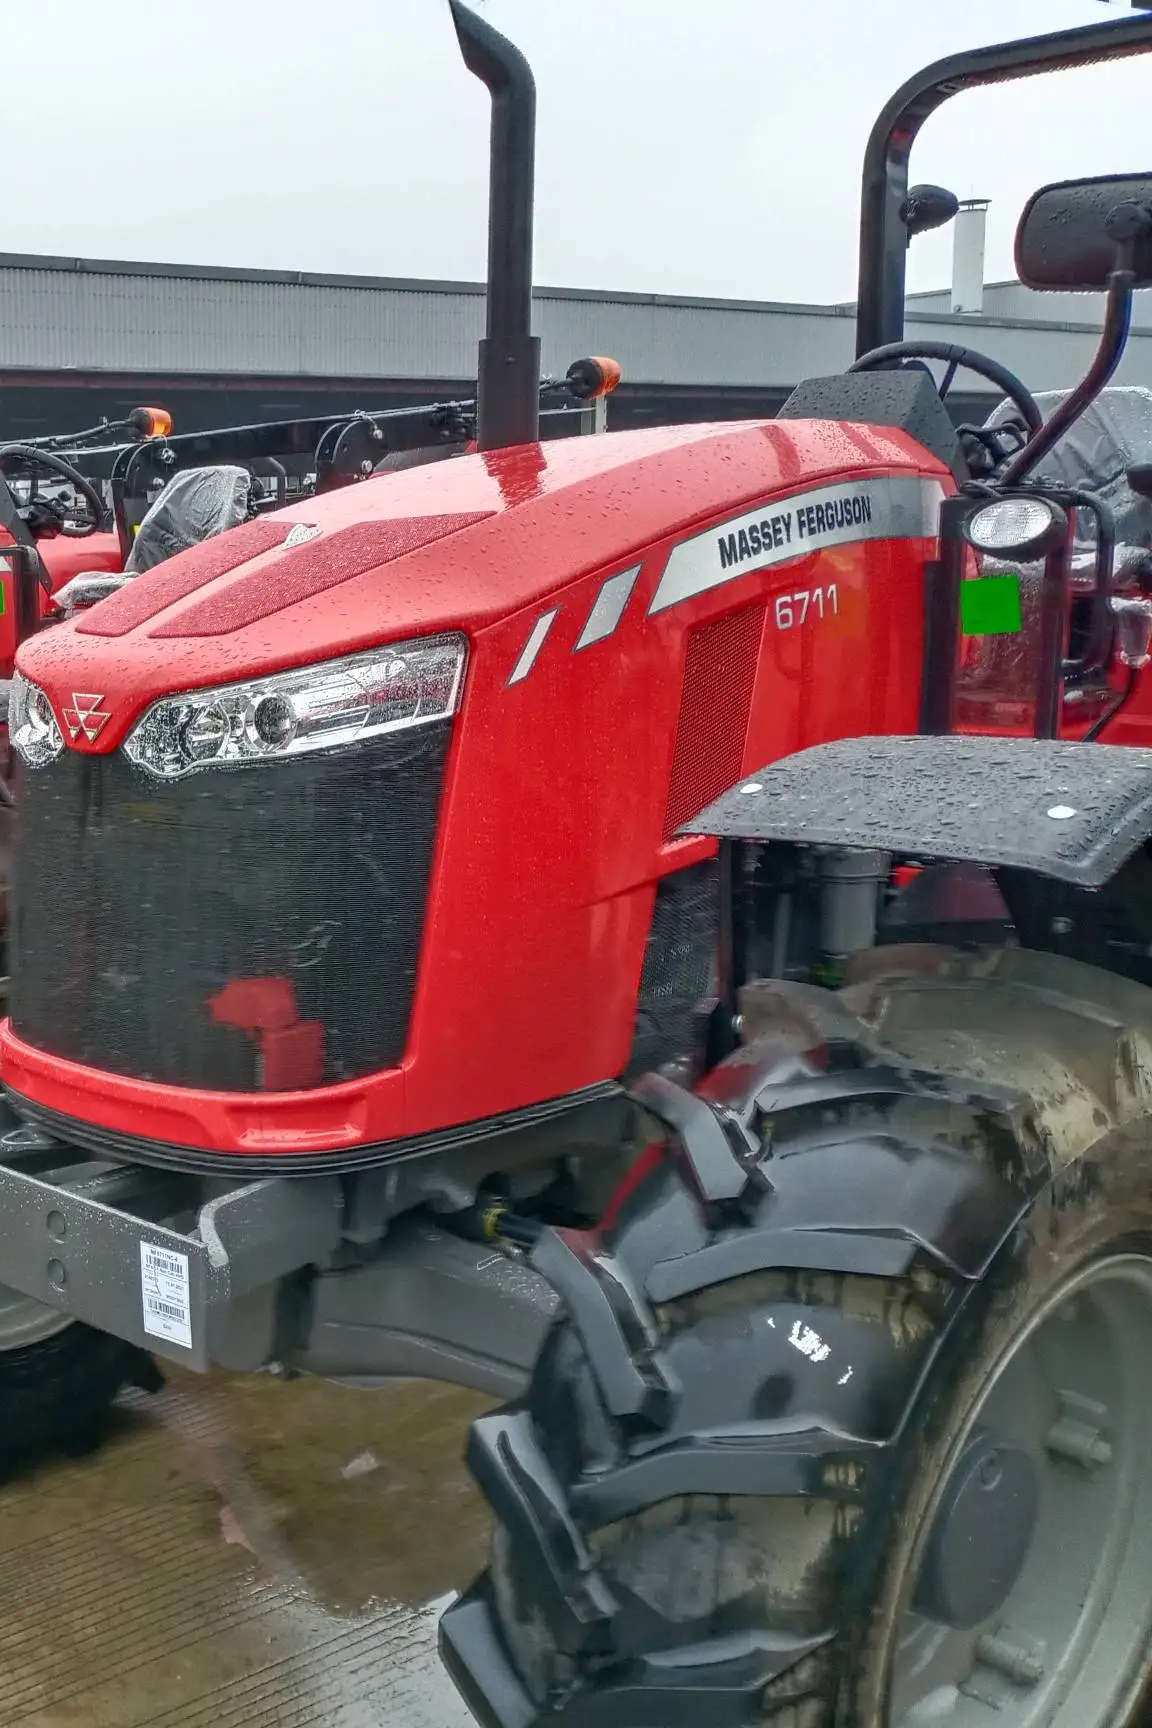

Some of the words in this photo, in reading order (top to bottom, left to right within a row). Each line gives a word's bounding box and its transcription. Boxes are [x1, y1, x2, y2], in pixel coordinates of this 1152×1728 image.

[717, 512, 792, 569] MASSEY
[796, 495, 872, 539] FERGUSON
[775, 583, 838, 630] 6711
